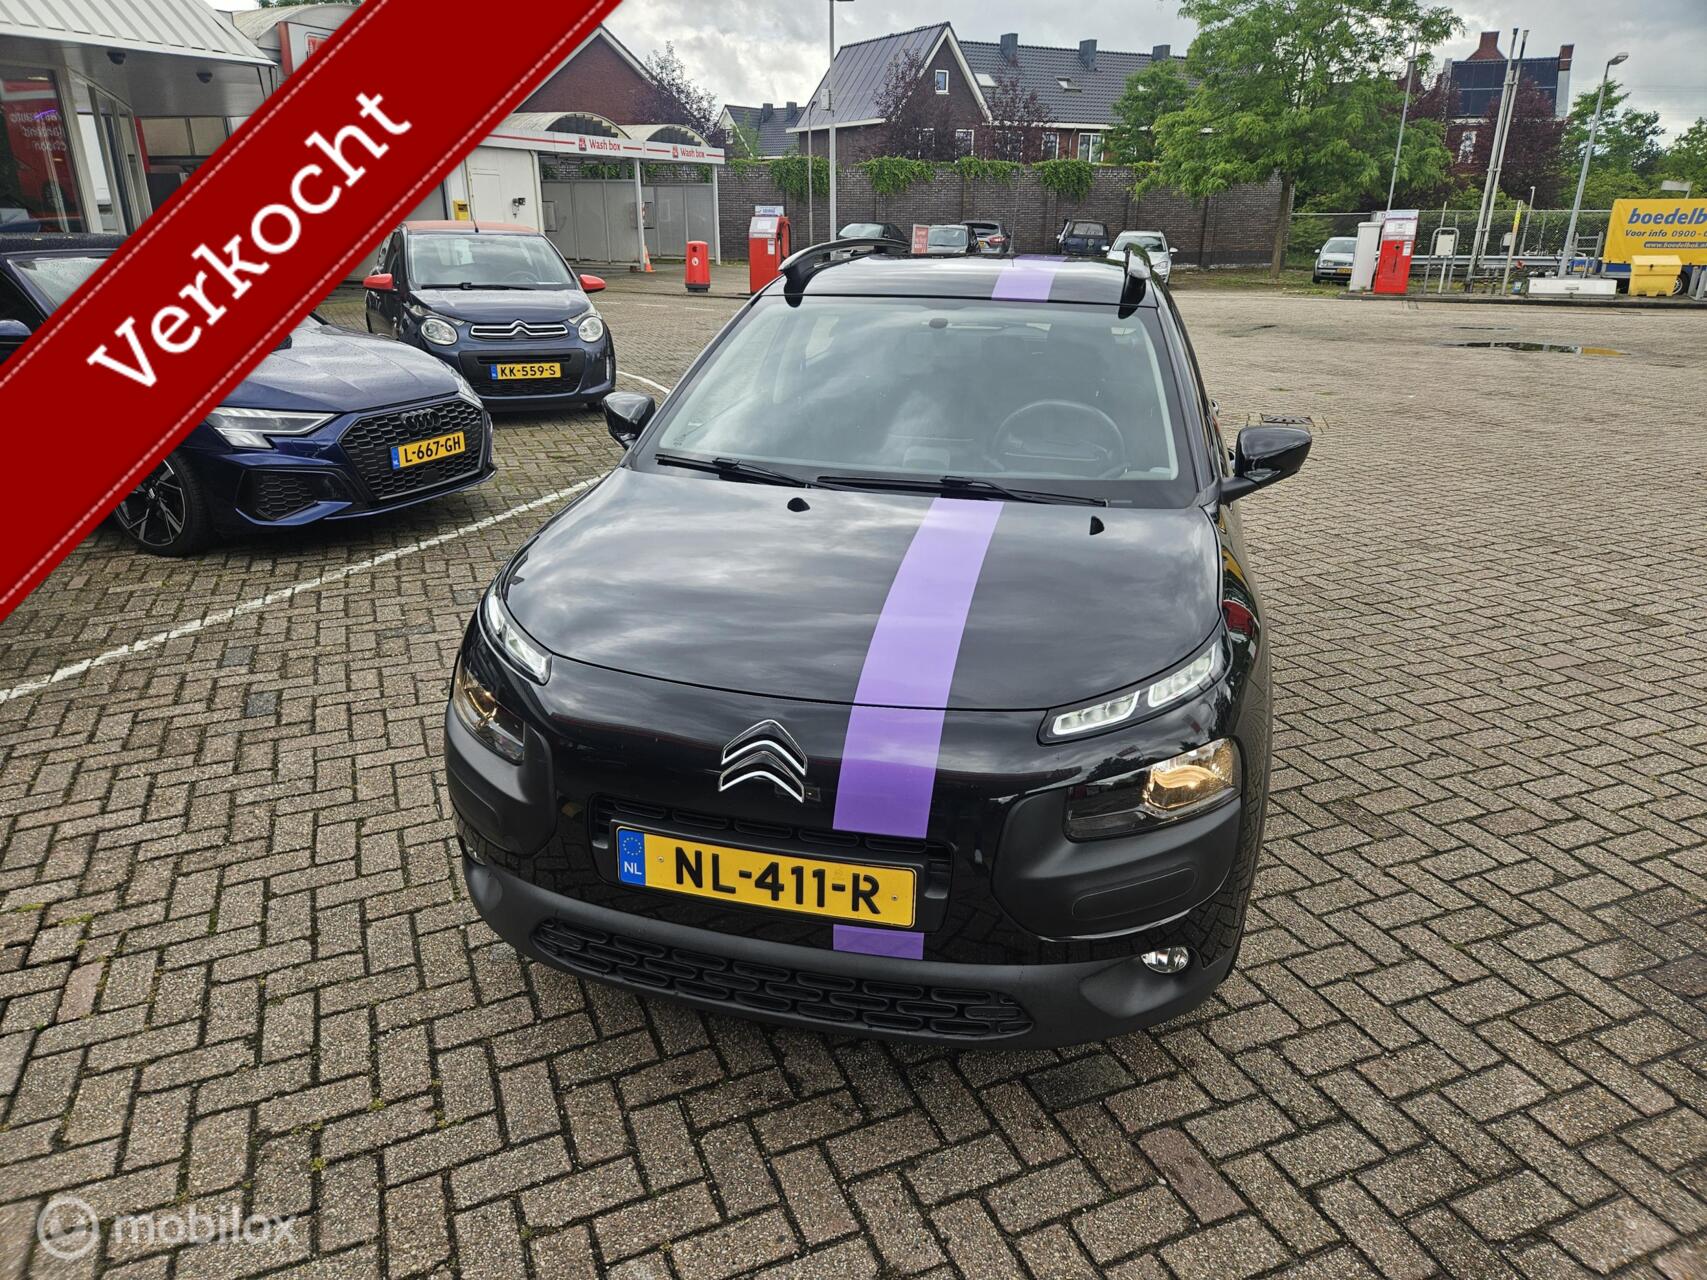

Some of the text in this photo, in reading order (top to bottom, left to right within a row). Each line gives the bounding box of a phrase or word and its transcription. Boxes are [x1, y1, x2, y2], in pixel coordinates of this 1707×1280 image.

[589, 138, 621, 151] Wash box
[681, 148, 705, 158] Wash box
[1625, 230, 1647, 238] Voor
[1648, 230, 1668, 238] info
[500, 365, 556, 377] KK-559-S
[404, 435, 461, 463] L-667-GH
[624, 861, 642, 875] NL
[675, 847, 881, 914] NL-411-R
